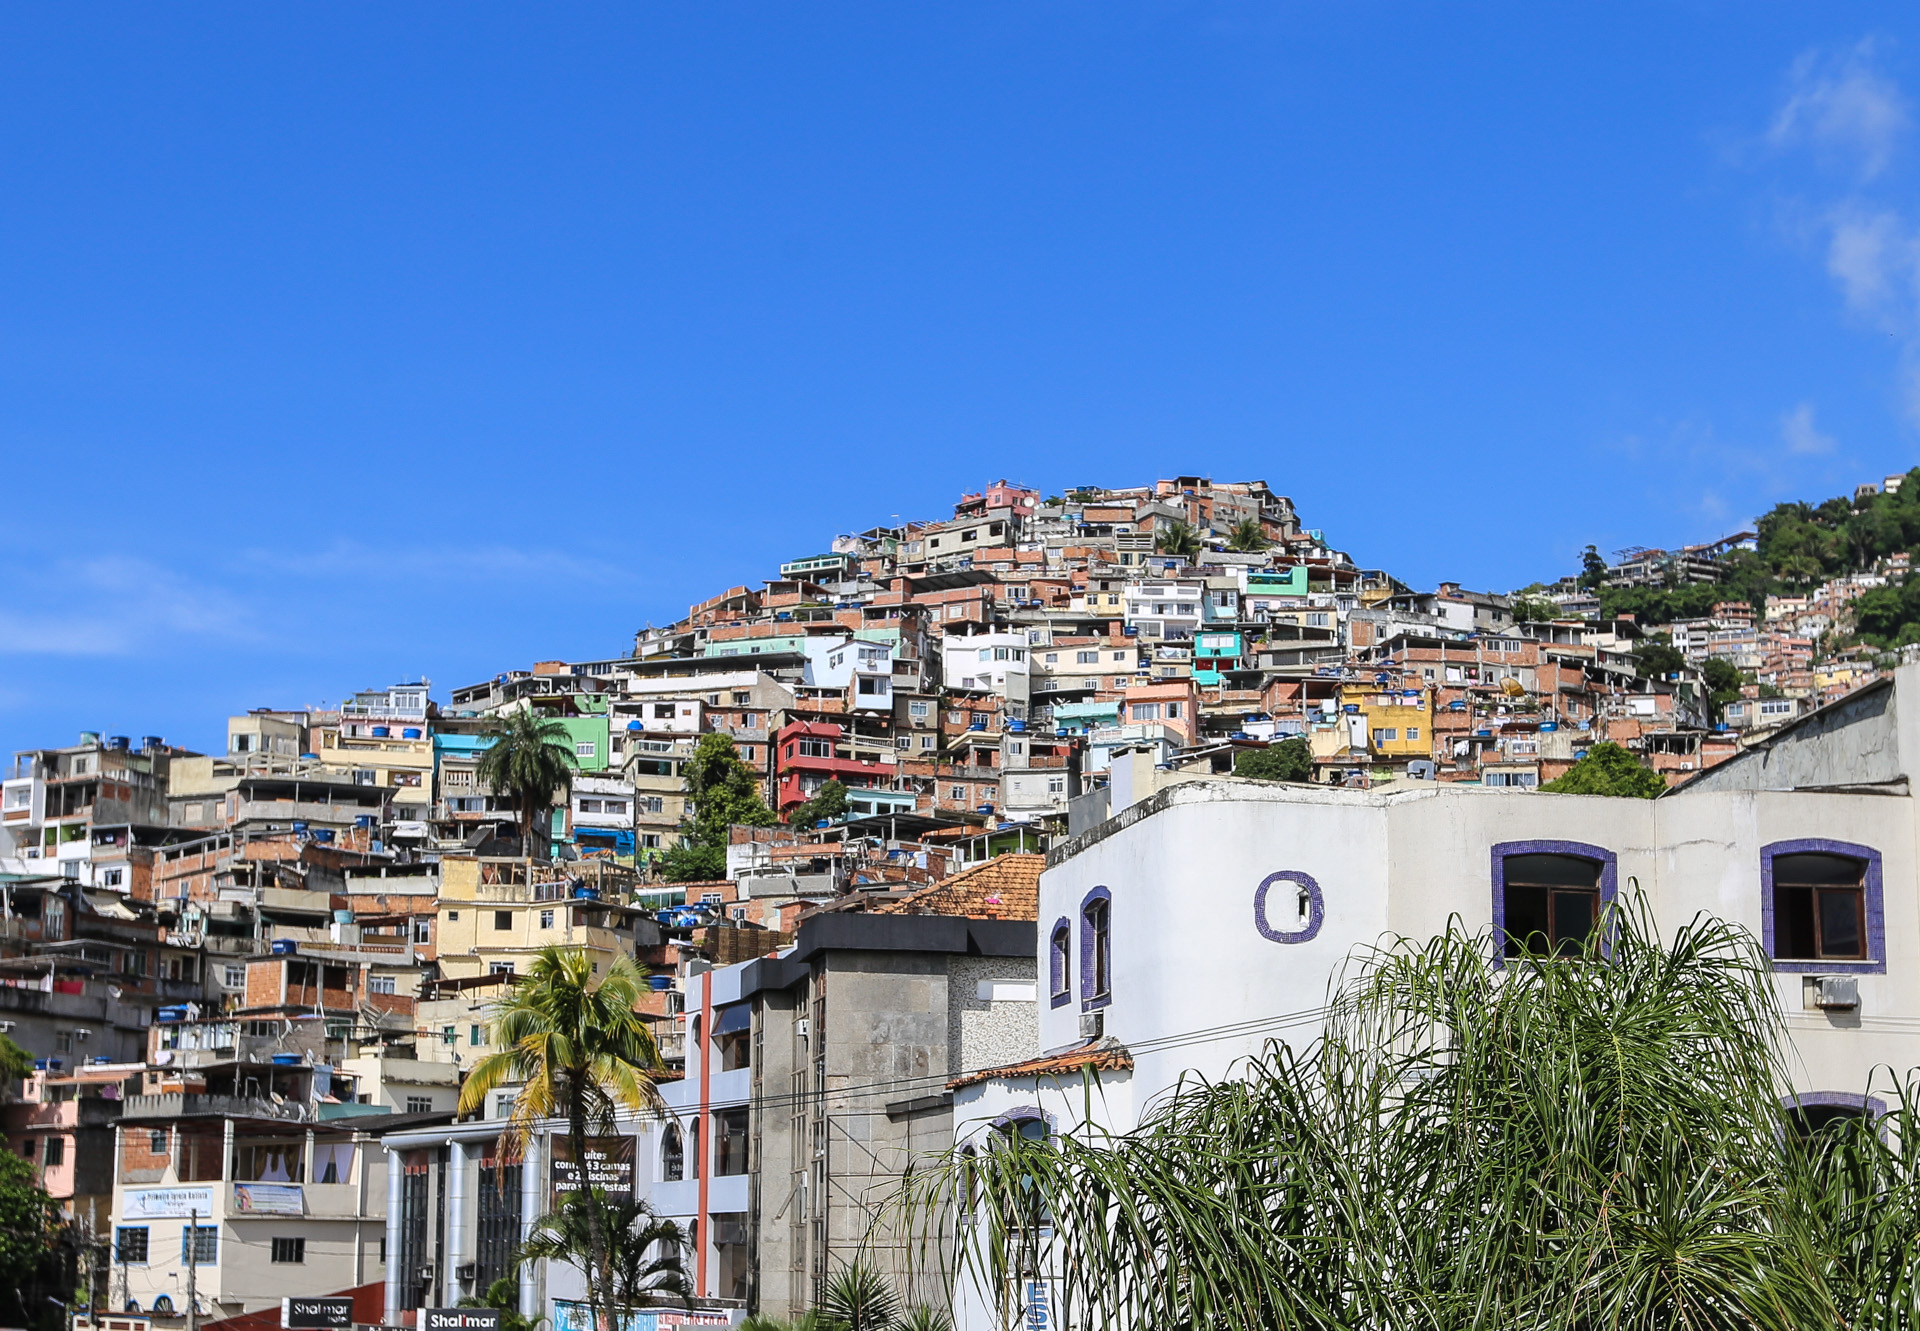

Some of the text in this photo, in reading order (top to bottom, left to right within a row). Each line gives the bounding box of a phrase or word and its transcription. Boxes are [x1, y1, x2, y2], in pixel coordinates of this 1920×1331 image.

[593, 1161, 600, 1171] 3
[600, 1163, 631, 1171] camas
[588, 1171, 620, 1181] iscinas
[556, 1182, 577, 1193] para
[294, 1302, 349, 1315] Shalmar
[430, 1313, 496, 1328] Shalimar
